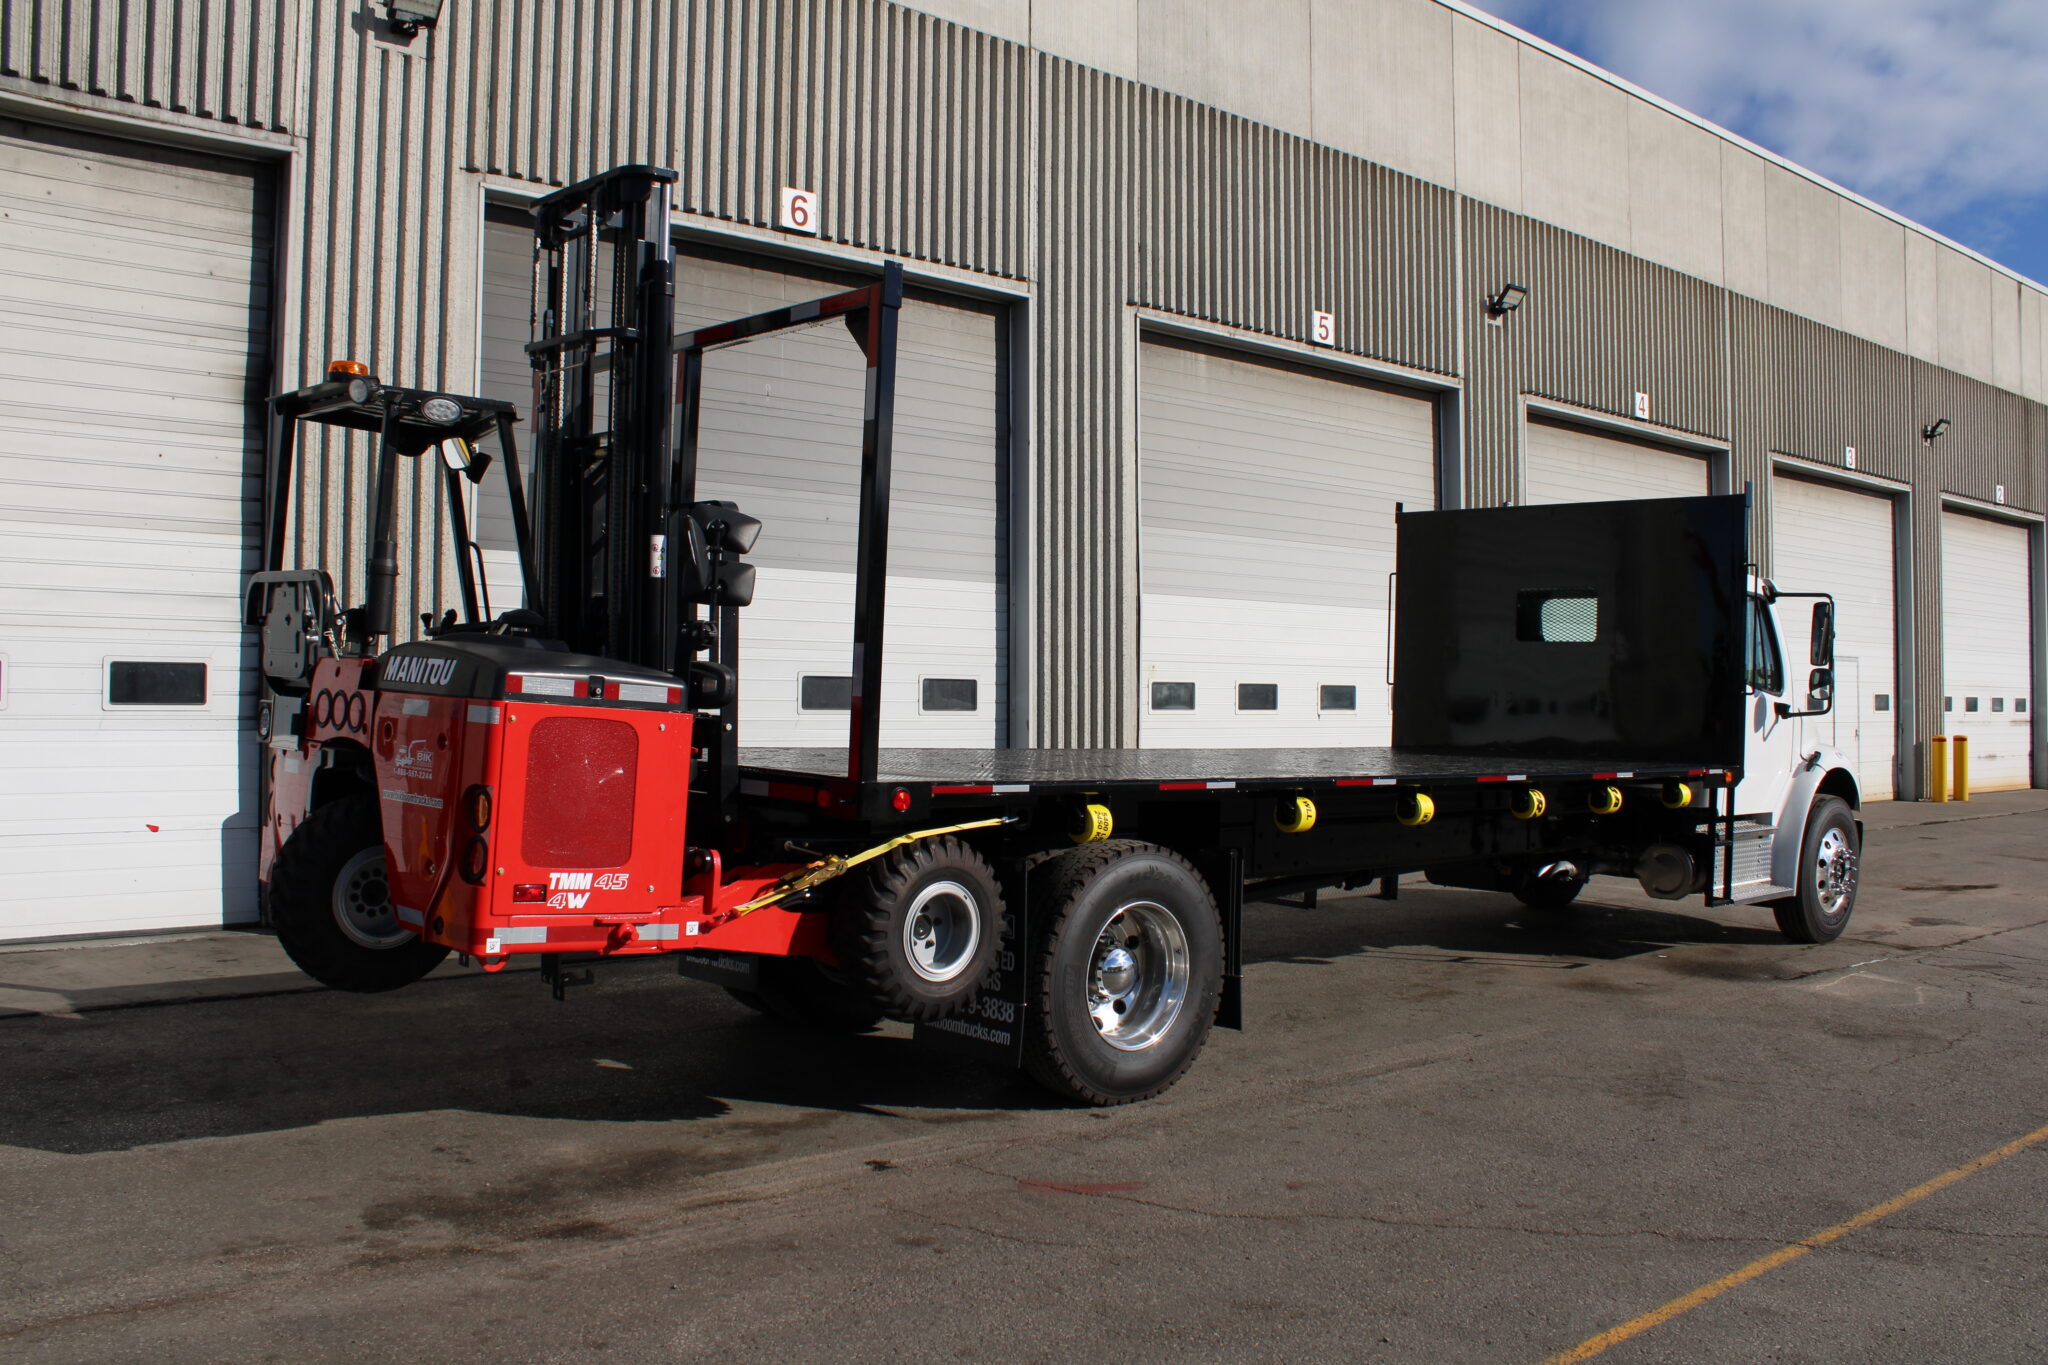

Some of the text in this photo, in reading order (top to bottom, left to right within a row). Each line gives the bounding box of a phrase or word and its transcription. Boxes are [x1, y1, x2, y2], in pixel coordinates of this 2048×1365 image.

[791, 195, 809, 226] 6
[1318, 315, 1329, 341] 5
[1638, 396, 1645, 416] 4
[1847, 449, 1854, 466] 3
[1997, 488, 2003, 502] 2
[384, 656, 457, 686] MANITOU
[417, 752, 432, 762] BIK
[1303, 801, 1313, 821] WLL
[549, 872, 629, 890] TMM 45
[547, 891, 590, 909] 4W
